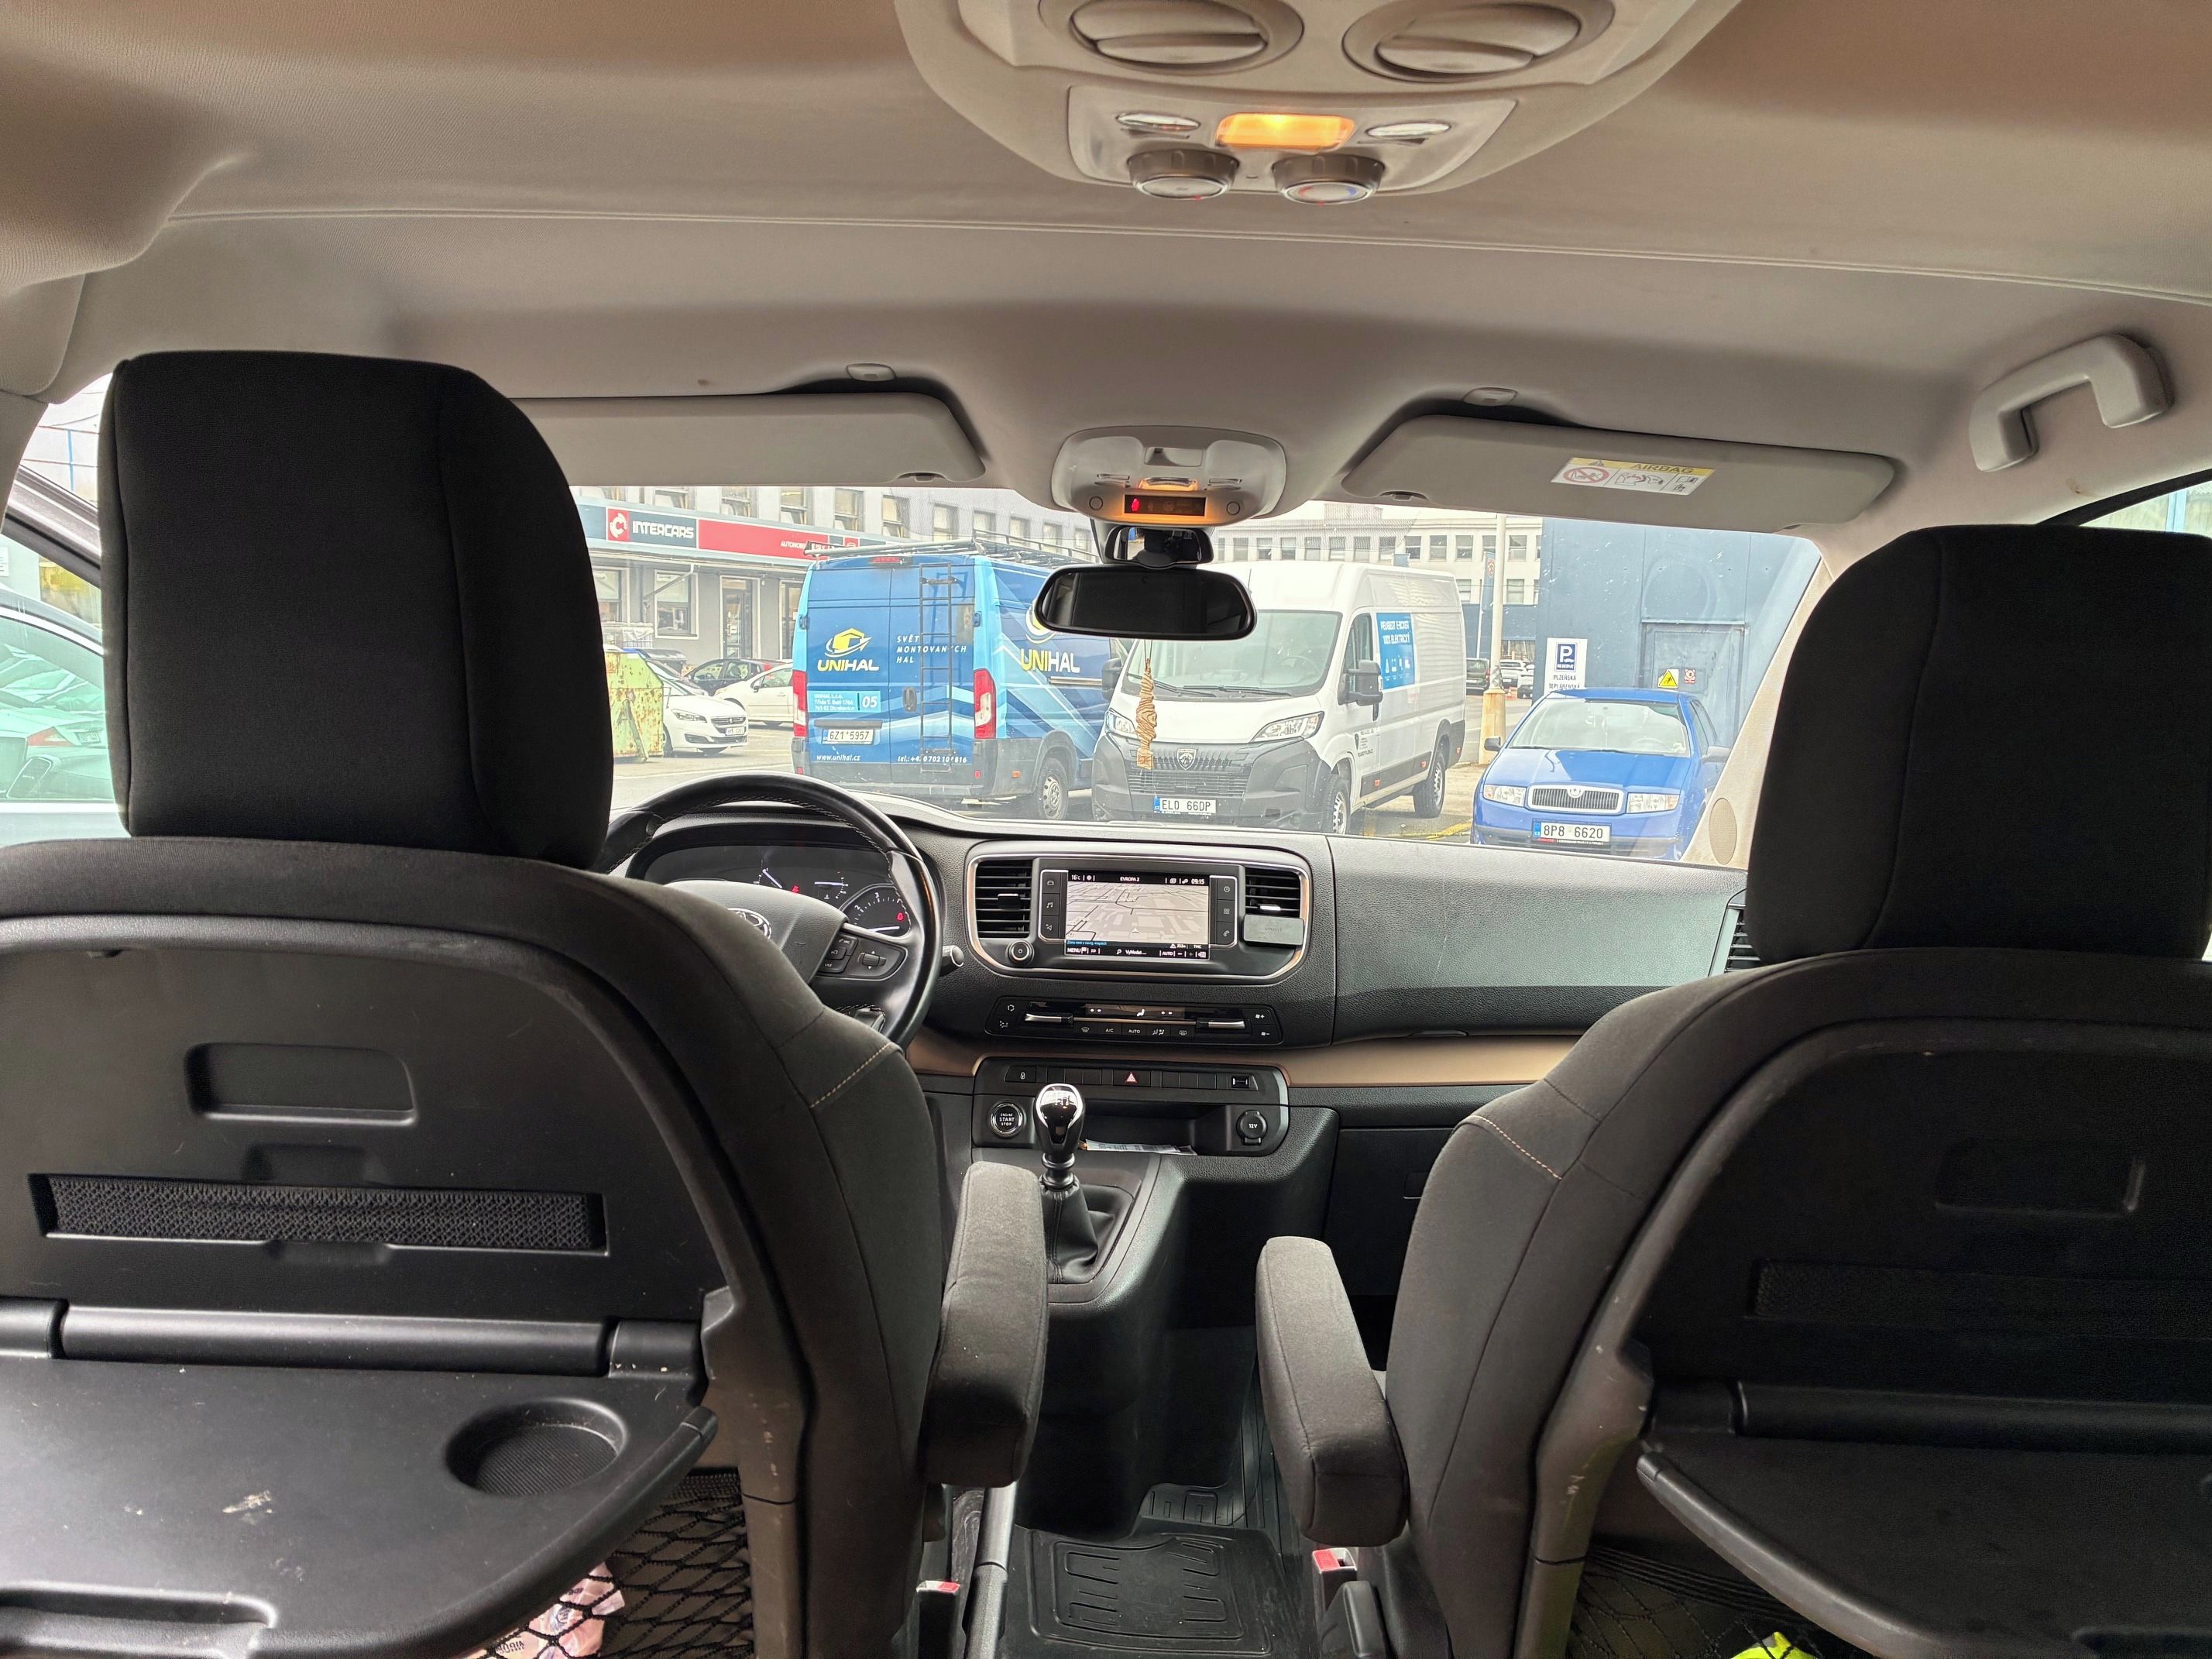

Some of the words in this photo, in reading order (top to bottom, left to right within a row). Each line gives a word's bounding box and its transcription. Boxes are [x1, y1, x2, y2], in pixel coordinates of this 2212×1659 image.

[1631, 464, 1694, 474] AIRBAG
[897, 634, 920, 643] SVĚT
[1559, 645, 1573, 662] P
[817, 659, 880, 672] UNIHAL
[1020, 648, 1080, 673] UNIHAL
[862, 696, 878, 708] 05
[830, 730, 844, 740] 6Z1
[850, 731, 870, 740] 5957
[1544, 825, 1565, 836] 8P8
[1574, 826, 1603, 839] 6620
